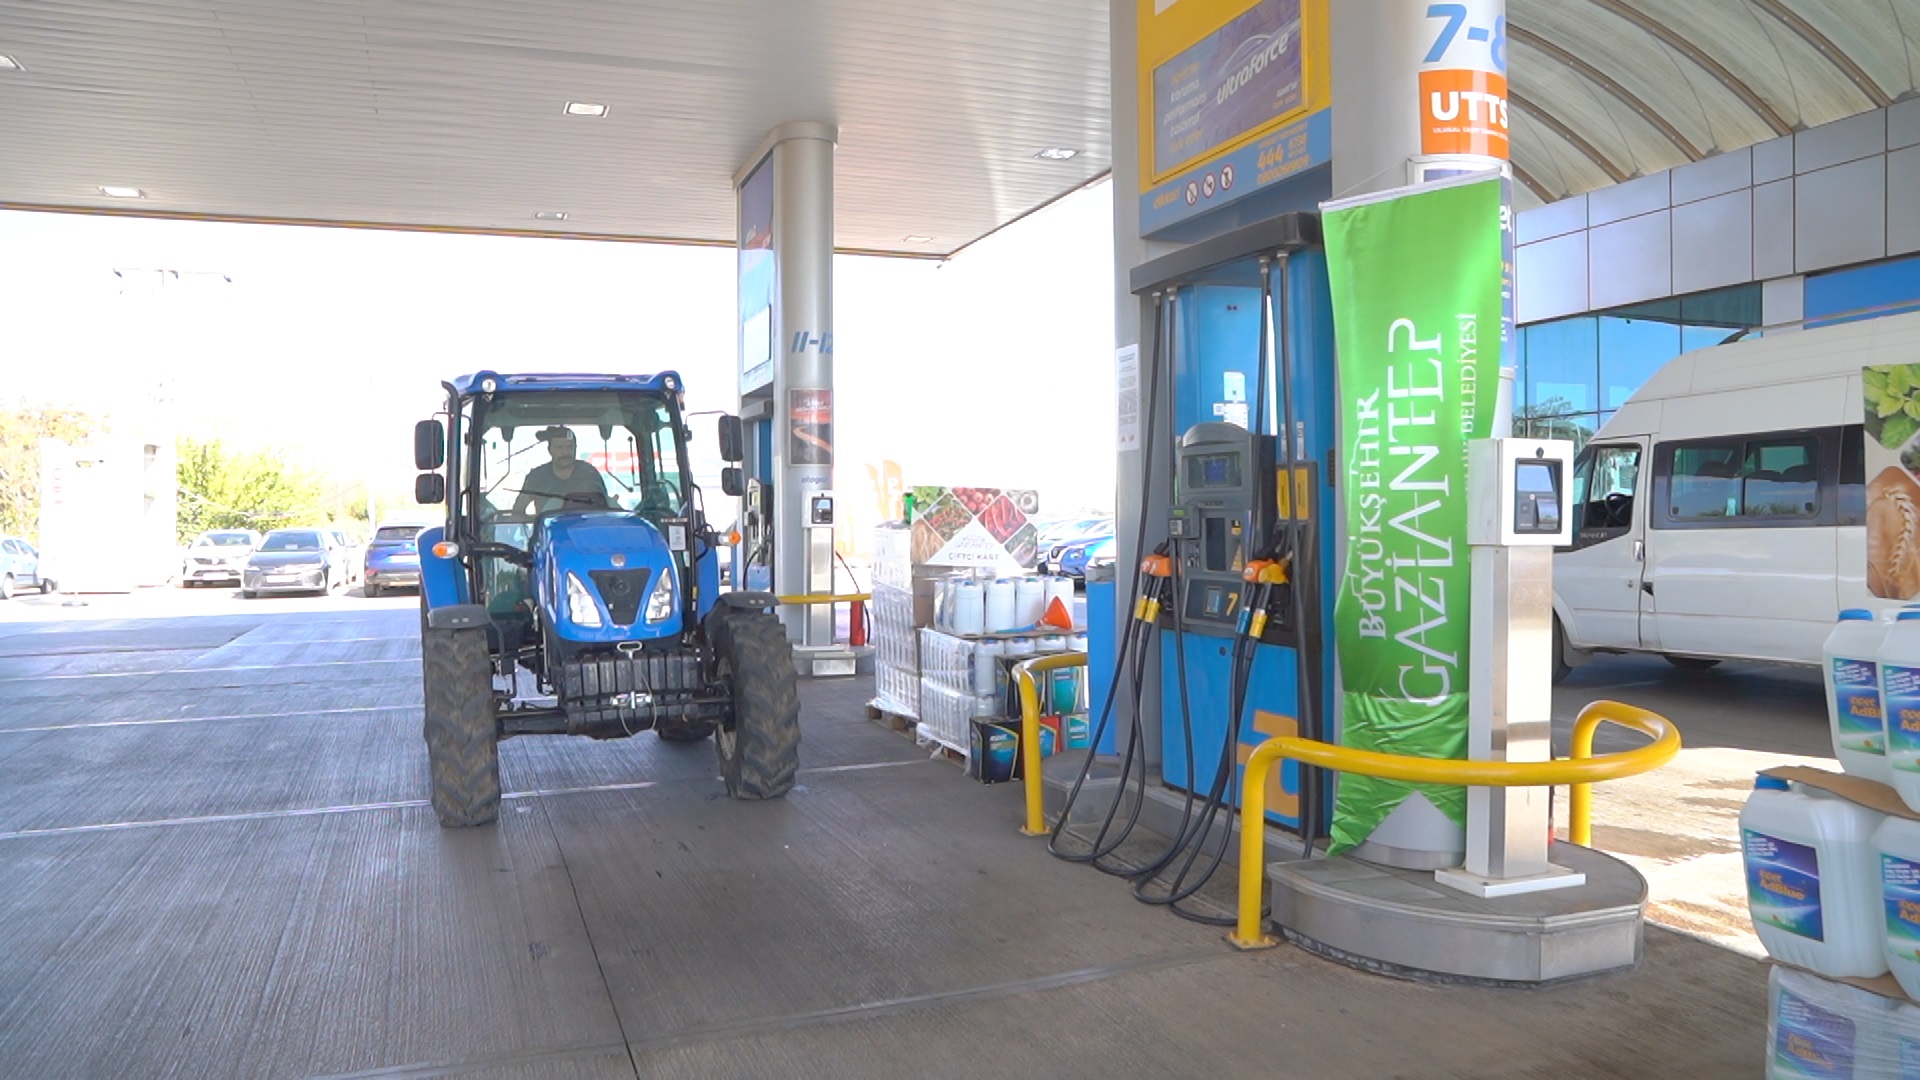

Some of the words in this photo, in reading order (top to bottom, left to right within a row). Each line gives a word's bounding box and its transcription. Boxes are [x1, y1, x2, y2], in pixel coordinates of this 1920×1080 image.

[1216, 31, 1290, 106] ultraforce
[1430, 90, 1508, 130] UTTS
[1454, 313, 1477, 433] BELEDİYESİ
[1384, 317, 1458, 707] GAZİANTEP
[1225, 591, 1239, 617] 7
